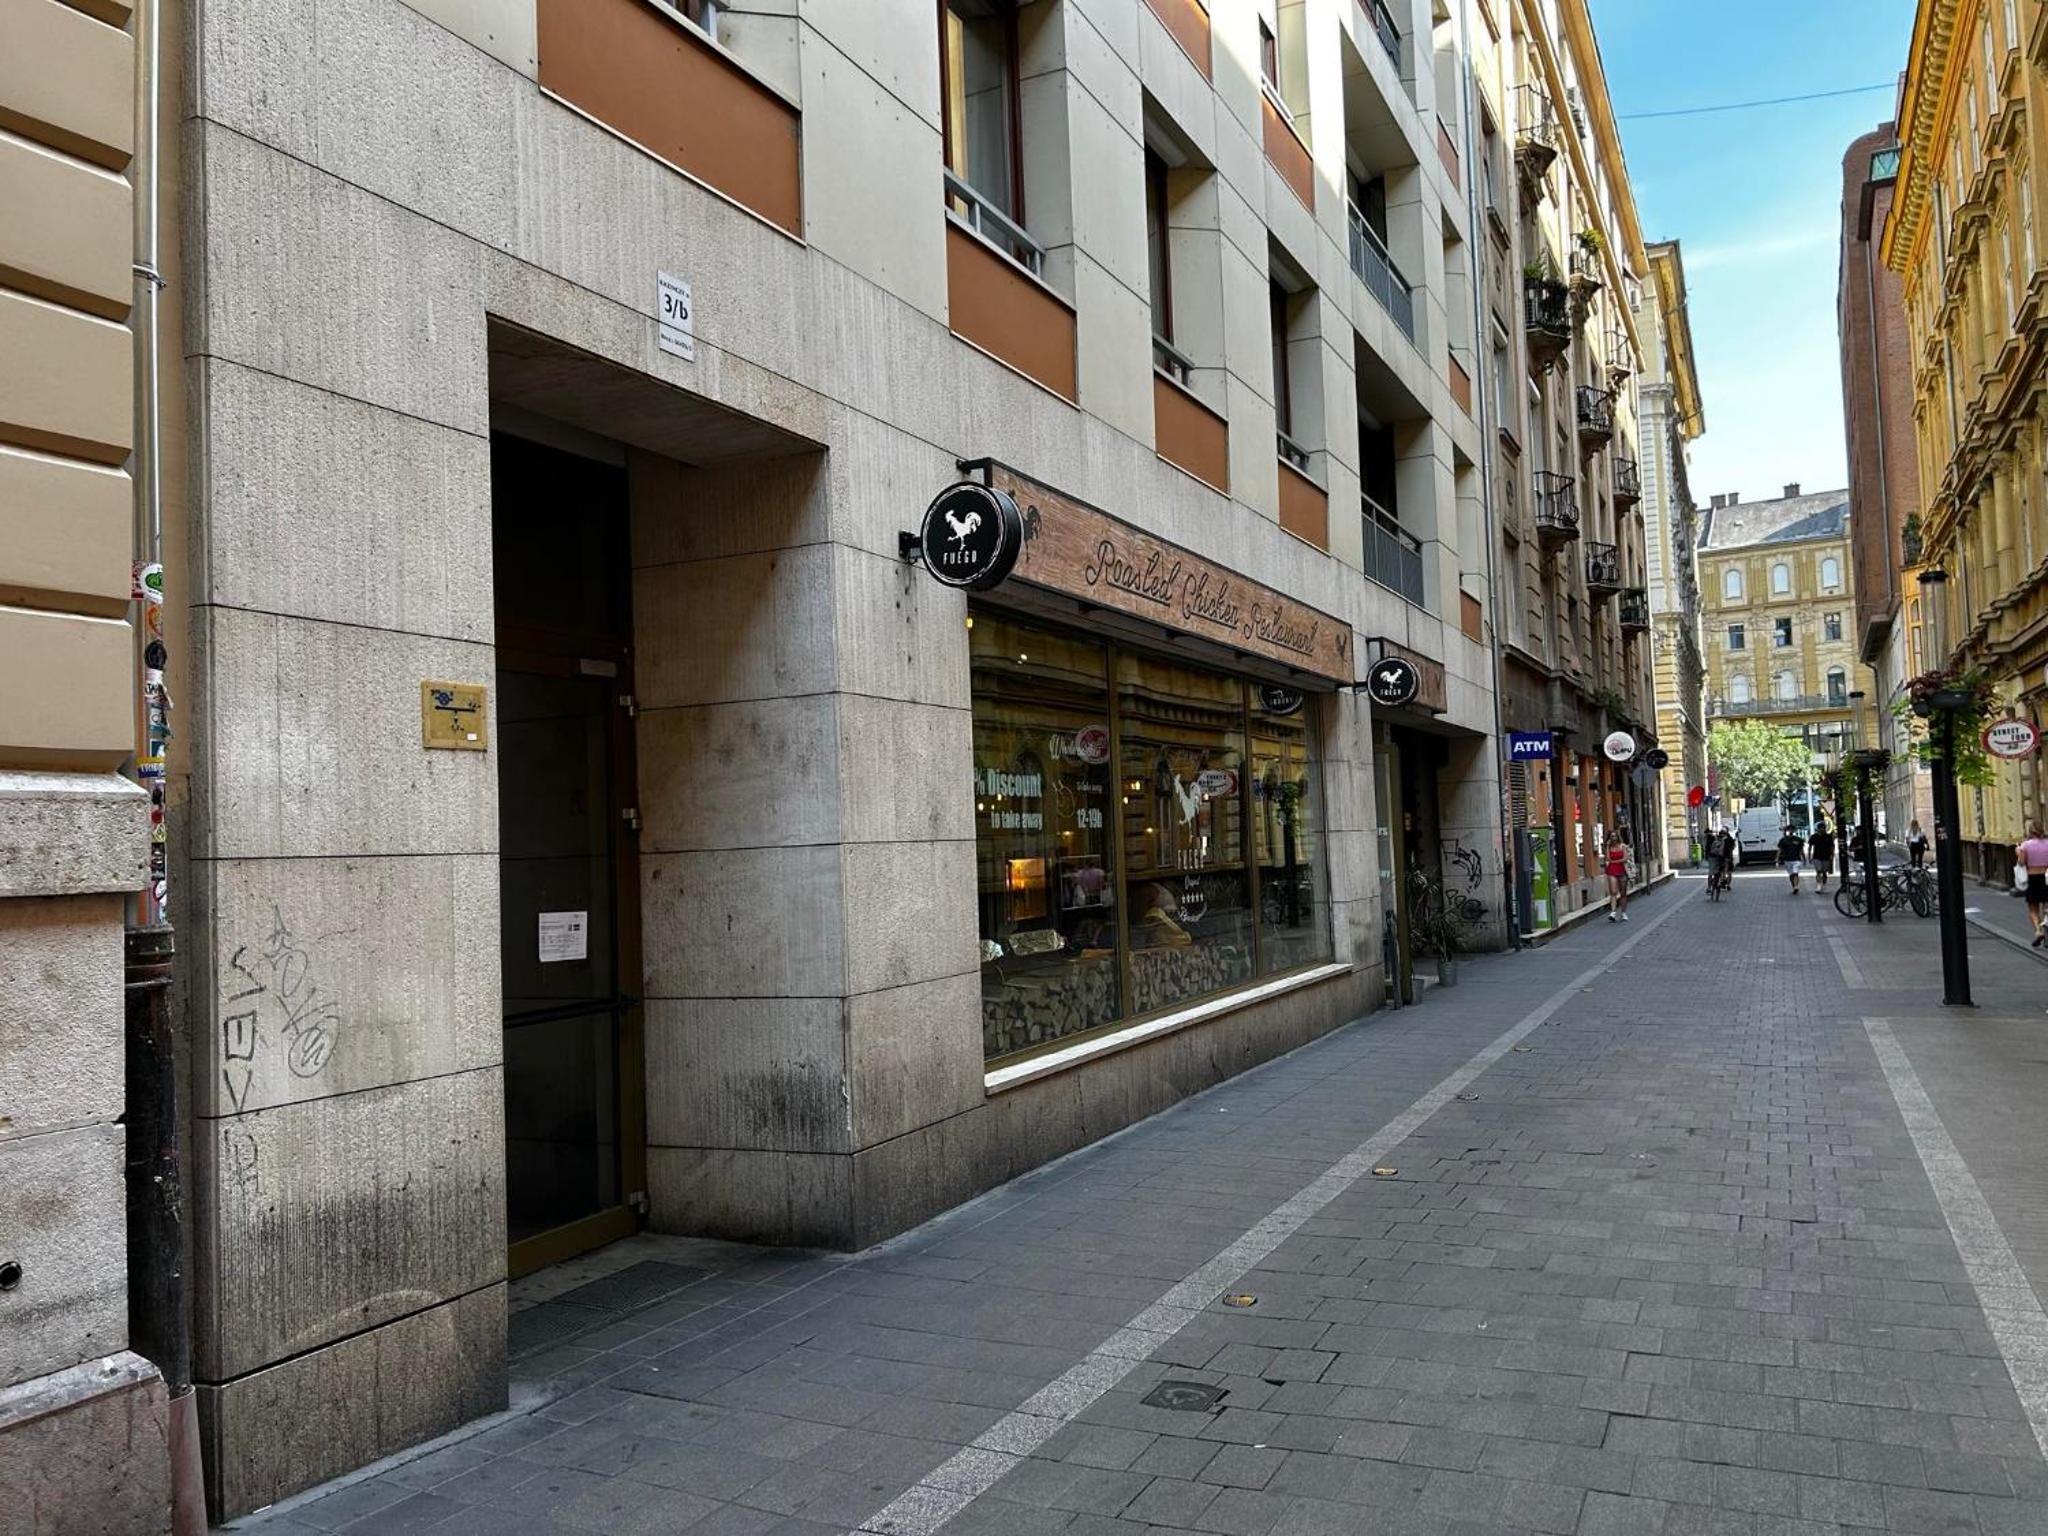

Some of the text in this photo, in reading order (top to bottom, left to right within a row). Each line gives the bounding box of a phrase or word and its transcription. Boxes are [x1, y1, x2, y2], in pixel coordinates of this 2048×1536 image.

[664, 293, 688, 320] 3/b
[943, 550, 978, 565] FUEGO
[1085, 539, 1319, 656] Roasted Chicken Restaurant
[1513, 741, 1549, 752] ATM
[987, 768, 1042, 797] Discount
[1001, 810, 1020, 828] take
[1022, 812, 1042, 830] away
